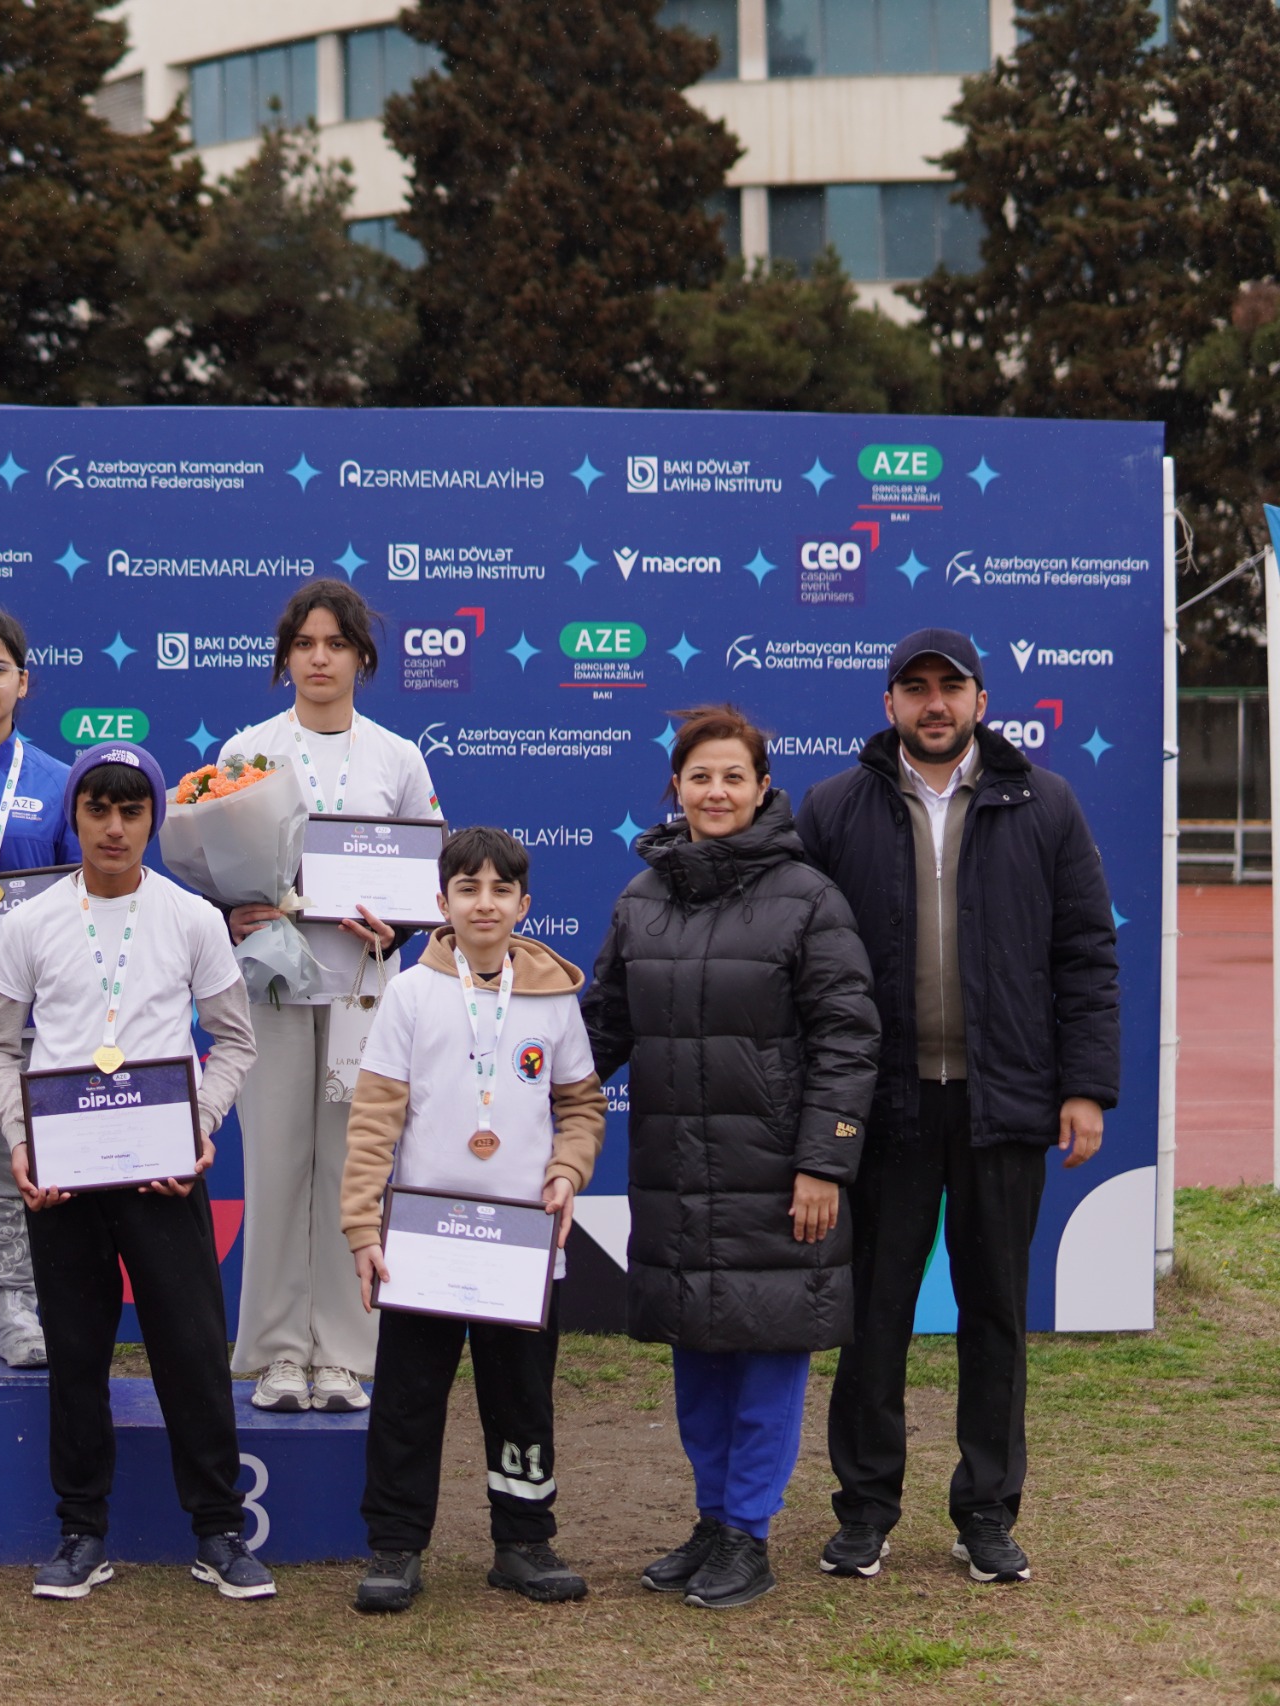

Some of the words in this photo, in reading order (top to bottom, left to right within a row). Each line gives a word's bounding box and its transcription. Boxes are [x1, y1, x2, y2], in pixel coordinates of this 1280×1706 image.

[87, 461, 176, 476] Azərbaycan
[179, 461, 264, 474] Kamandan
[663, 462, 693, 474] BAKI
[697, 459, 750, 474] DÖVLƏT
[873, 452, 927, 475] AZE
[87, 475, 147, 489] Oxatma
[151, 475, 245, 491] Federasiyası
[663, 476, 711, 492] LAYİHƏ
[714, 477, 782, 492] İNSTİTUTU
[425, 549, 455, 561] BAKI
[458, 546, 513, 562] DÖVLƏT
[801, 542, 861, 570] ceo
[425, 564, 472, 580] LAYİHƏ
[476, 564, 545, 580] İNSTİTUTU
[642, 556, 720, 572] macron
[985, 557, 1068, 572] Azərbaycan
[1071, 557, 1149, 571] Kamandan
[801, 572, 841, 583] caspian
[985, 571, 1041, 585] Oxatma
[1044, 571, 1131, 588] Federasiyası
[801, 581, 830, 591] event
[801, 590, 854, 602] organisers
[195, 637, 225, 650] BAKI
[404, 628, 466, 656] ceo
[574, 629, 631, 652] AZE
[765, 640, 851, 656] Azərbaycan
[194, 653, 243, 668] LAYİHƏ
[404, 659, 446, 670] caspian
[765, 655, 822, 669] Oxatma
[827, 655, 890, 669] Federasi
[1038, 648, 1113, 665] macron
[404, 669, 434, 678] event
[404, 677, 459, 689] organisers
[592, 692, 613, 700] BAKI
[76, 715, 134, 738] AZE
[458, 728, 545, 743] Azərbaycan
[549, 727, 631, 741] Kamandan
[101, 752, 126, 760] NORTH
[458, 743, 516, 756] Oxatma
[520, 743, 612, 759] Federasiyası
[12, 799, 36, 809] AZE
[343, 839, 400, 855] DİPLOM
[78, 1091, 141, 1109] DİPLOM
[437, 1219, 502, 1241] DİPLOM
[501, 1440, 544, 1481] 01
